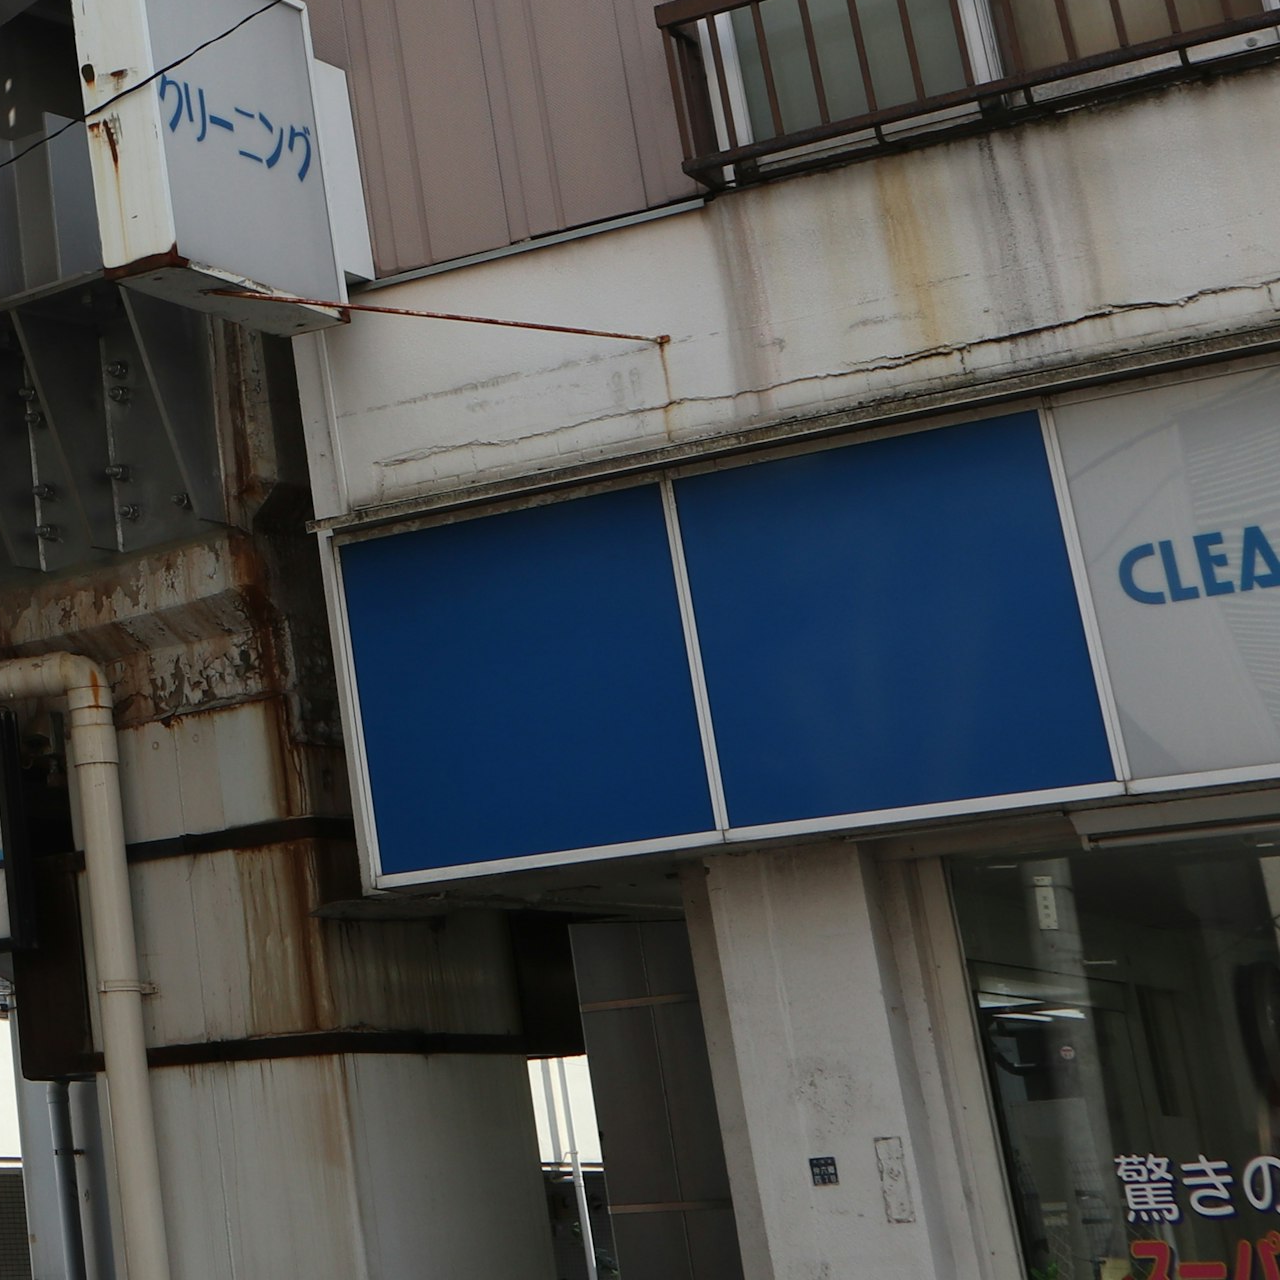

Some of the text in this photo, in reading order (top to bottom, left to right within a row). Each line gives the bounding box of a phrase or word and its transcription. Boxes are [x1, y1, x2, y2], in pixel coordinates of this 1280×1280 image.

[159, 74, 312, 183] クリーニング
[1117, 525, 1280, 606] CLEA
[1113, 1152, 1280, 1224] 驚きの
